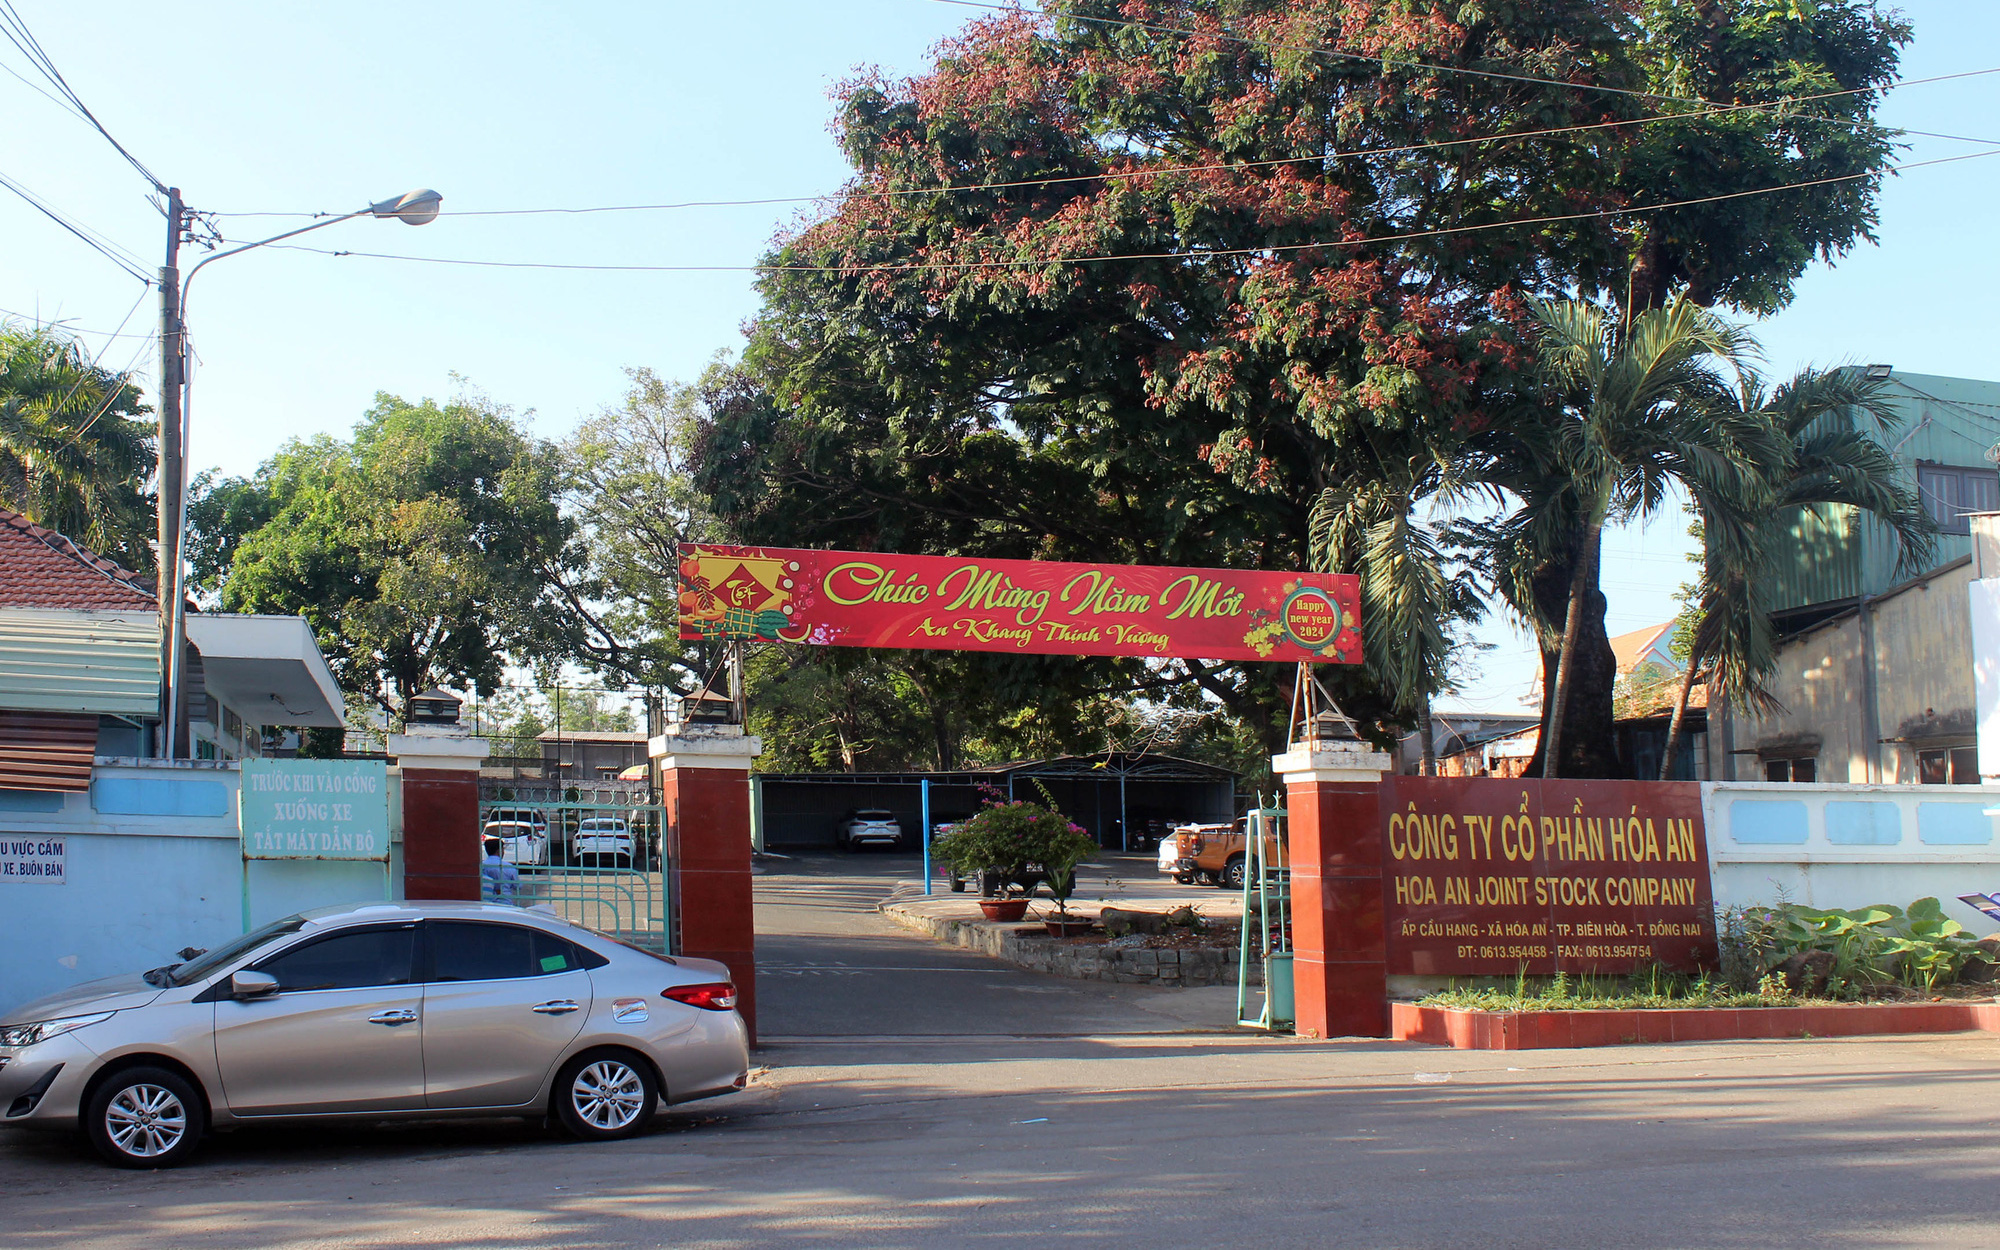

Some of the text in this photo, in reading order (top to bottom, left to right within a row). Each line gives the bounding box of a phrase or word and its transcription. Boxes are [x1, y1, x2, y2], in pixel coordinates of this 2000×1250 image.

[823, 562, 1246, 626] Chúc Mừng Năm Mới
[1296, 599, 1325, 613] Happy
[1290, 614, 1332, 626] new year
[908, 617, 1170, 652] An Khang Thịnh Vượng
[1299, 626, 1324, 637] 2024
[251, 766, 376, 794] TRƯỚC KHI VÀO CỔNG
[274, 797, 353, 821] XUỐNG XE
[1388, 790, 1697, 862] CÔNG TY CỔ PHẦN HÓA AN
[11, 840, 35, 858] VỰC
[37, 837, 63, 856] CẤM
[254, 825, 283, 850] TẮT
[286, 828, 318, 851] MÁY
[355, 829, 375, 856] BỘ
[20, 859, 43, 876] BUÔN
[45, 860, 63, 876] BÁN
[1394, 876, 1697, 906] HOA AN JOINT STOCK COMPANY
[1401, 918, 1417, 936] ẤP
[1419, 918, 1443, 937] CẦU
[1488, 921, 1502, 937] XÃ
[1505, 920, 1529, 937] HÓA
[1532, 923, 1547, 937] AN
[1556, 923, 1575, 937] TP.
[1576, 920, 1602, 937] BIÊN
[1605, 920, 1628, 937] HÒA
[1637, 923, 1648, 936] T.
[1650, 918, 1680, 937] ĐỒNG
[1682, 923, 1701, 936] NAI
[1457, 945, 1478, 958] ĐT:
[1480, 945, 1547, 958] 0613.954458
[1557, 945, 1583, 957] FAX:
[1585, 945, 1652, 958] 0613.954754
